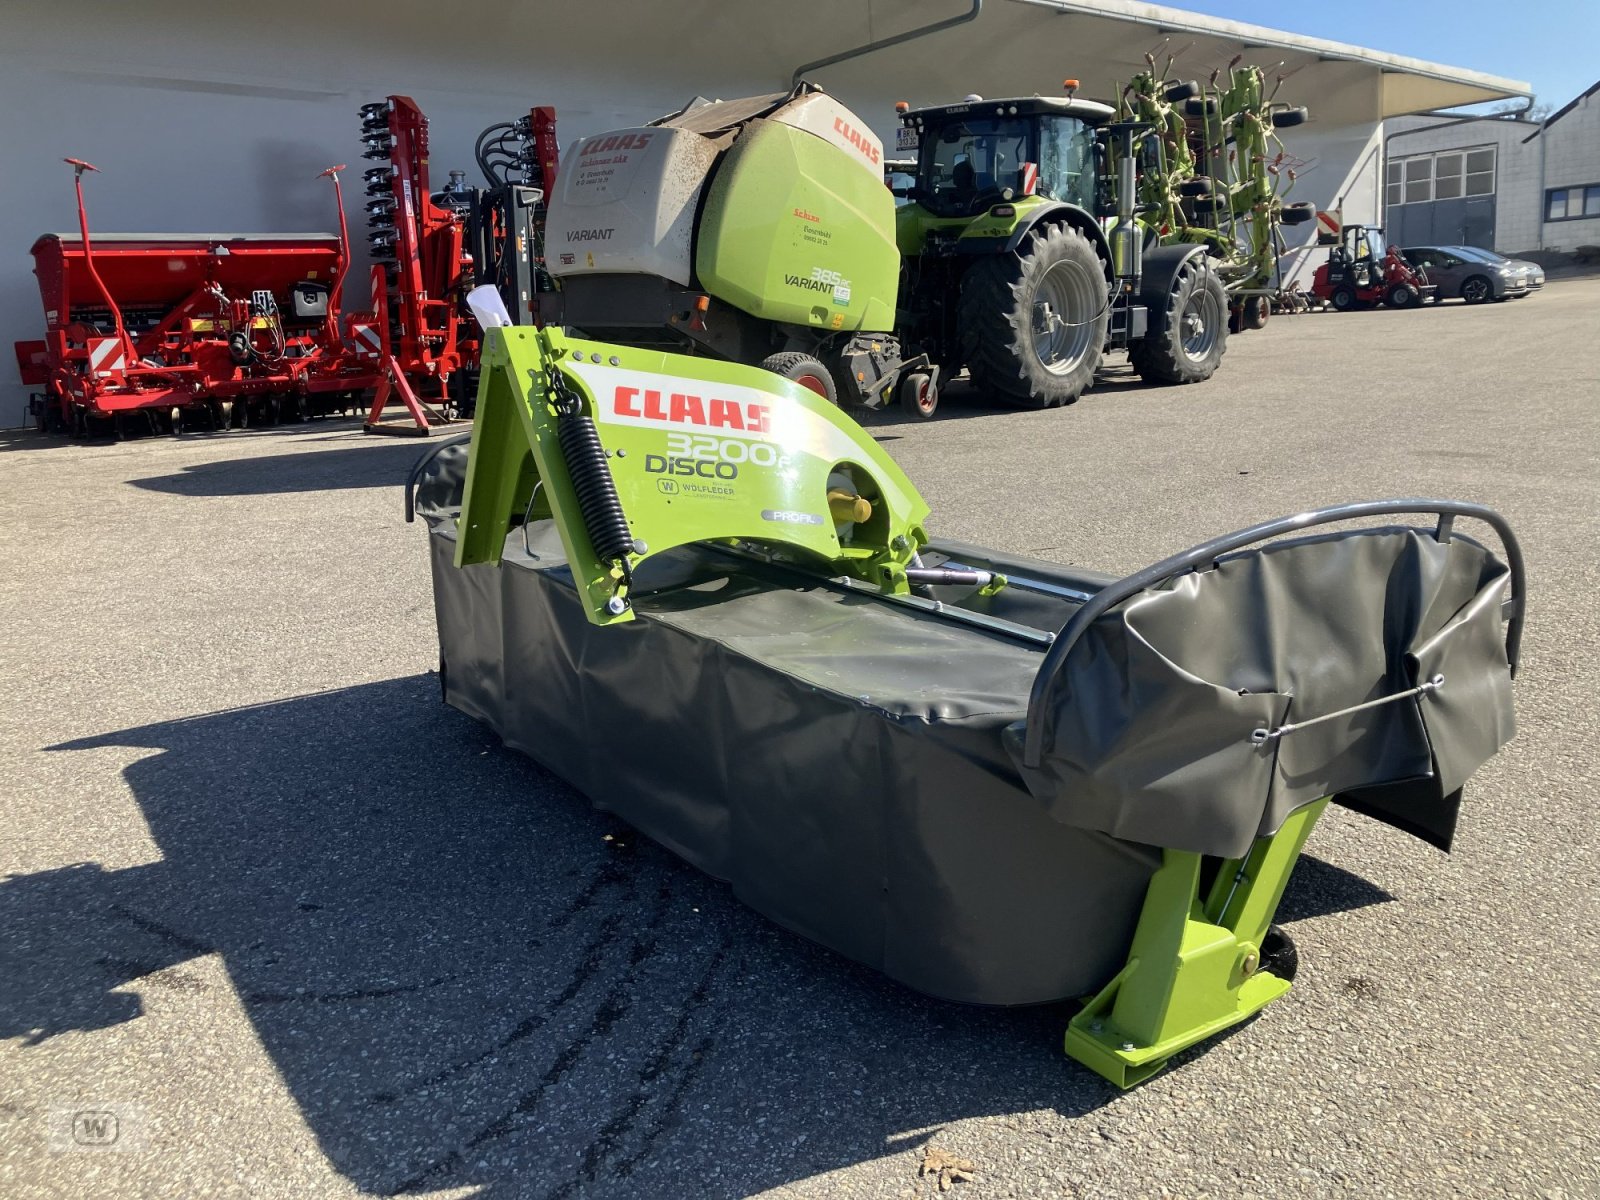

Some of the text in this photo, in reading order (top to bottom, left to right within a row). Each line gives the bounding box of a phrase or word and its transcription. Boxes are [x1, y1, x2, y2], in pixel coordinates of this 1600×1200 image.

[579, 133, 656, 157] CLAAS
[834, 117, 880, 165] CLAAS
[567, 228, 615, 242] VARIANT
[785, 274, 834, 294] VARIANT
[613, 386, 771, 433] CLAAS
[773, 511, 817, 524] PROFIL
